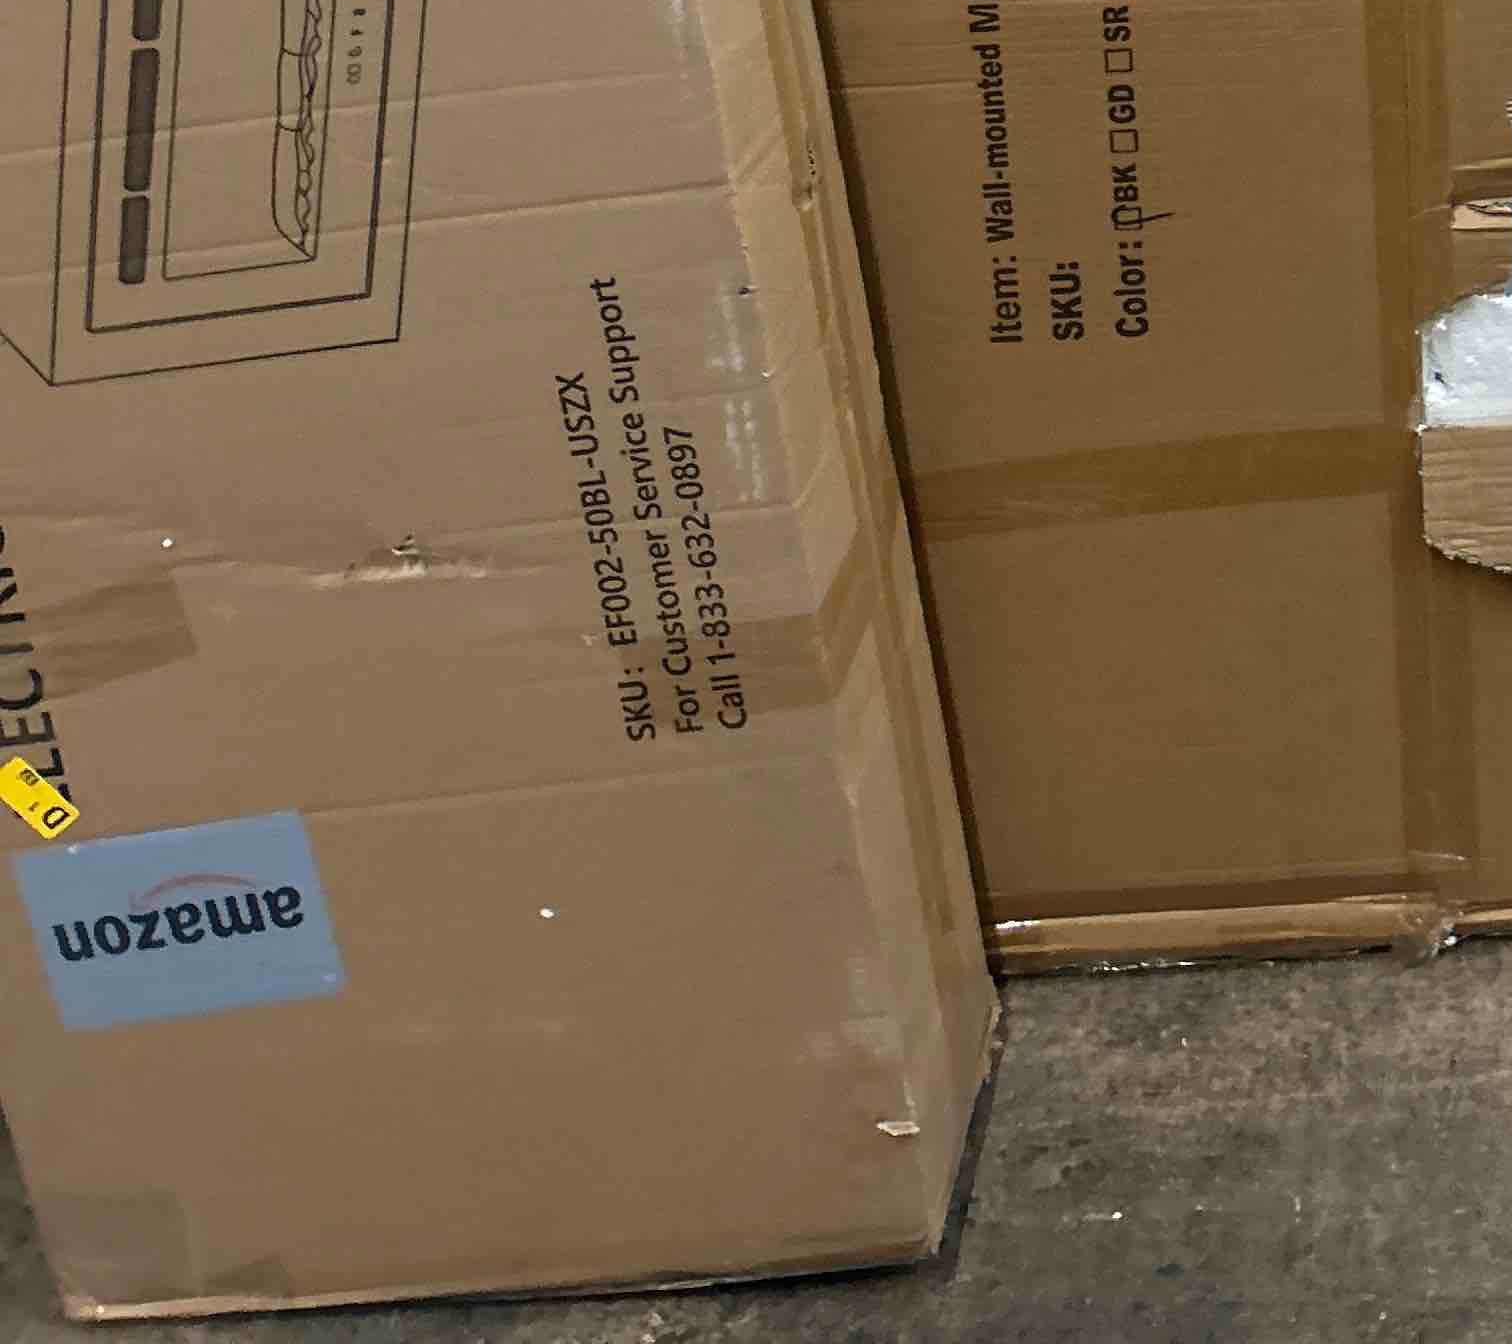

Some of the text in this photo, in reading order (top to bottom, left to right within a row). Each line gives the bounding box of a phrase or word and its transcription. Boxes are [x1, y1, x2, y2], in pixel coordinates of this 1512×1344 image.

[1102, 5, 1131, 43] SR
[971, 44, 1015, 244] Wall-mounted
[1108, 83, 1136, 124] GD
[1113, 164, 1139, 205] BK
[990, 254, 1023, 343] Item:
[1049, 260, 1084, 341] SKU:
[1115, 240, 1149, 338] Color:
[589, 276, 703, 735] For Customer Service Support
[555, 372, 656, 742] SKU: EF002-50BL-USZX
[663, 426, 748, 730] Call 1-833-632-0897
[52, 884, 305, 963] amazon
